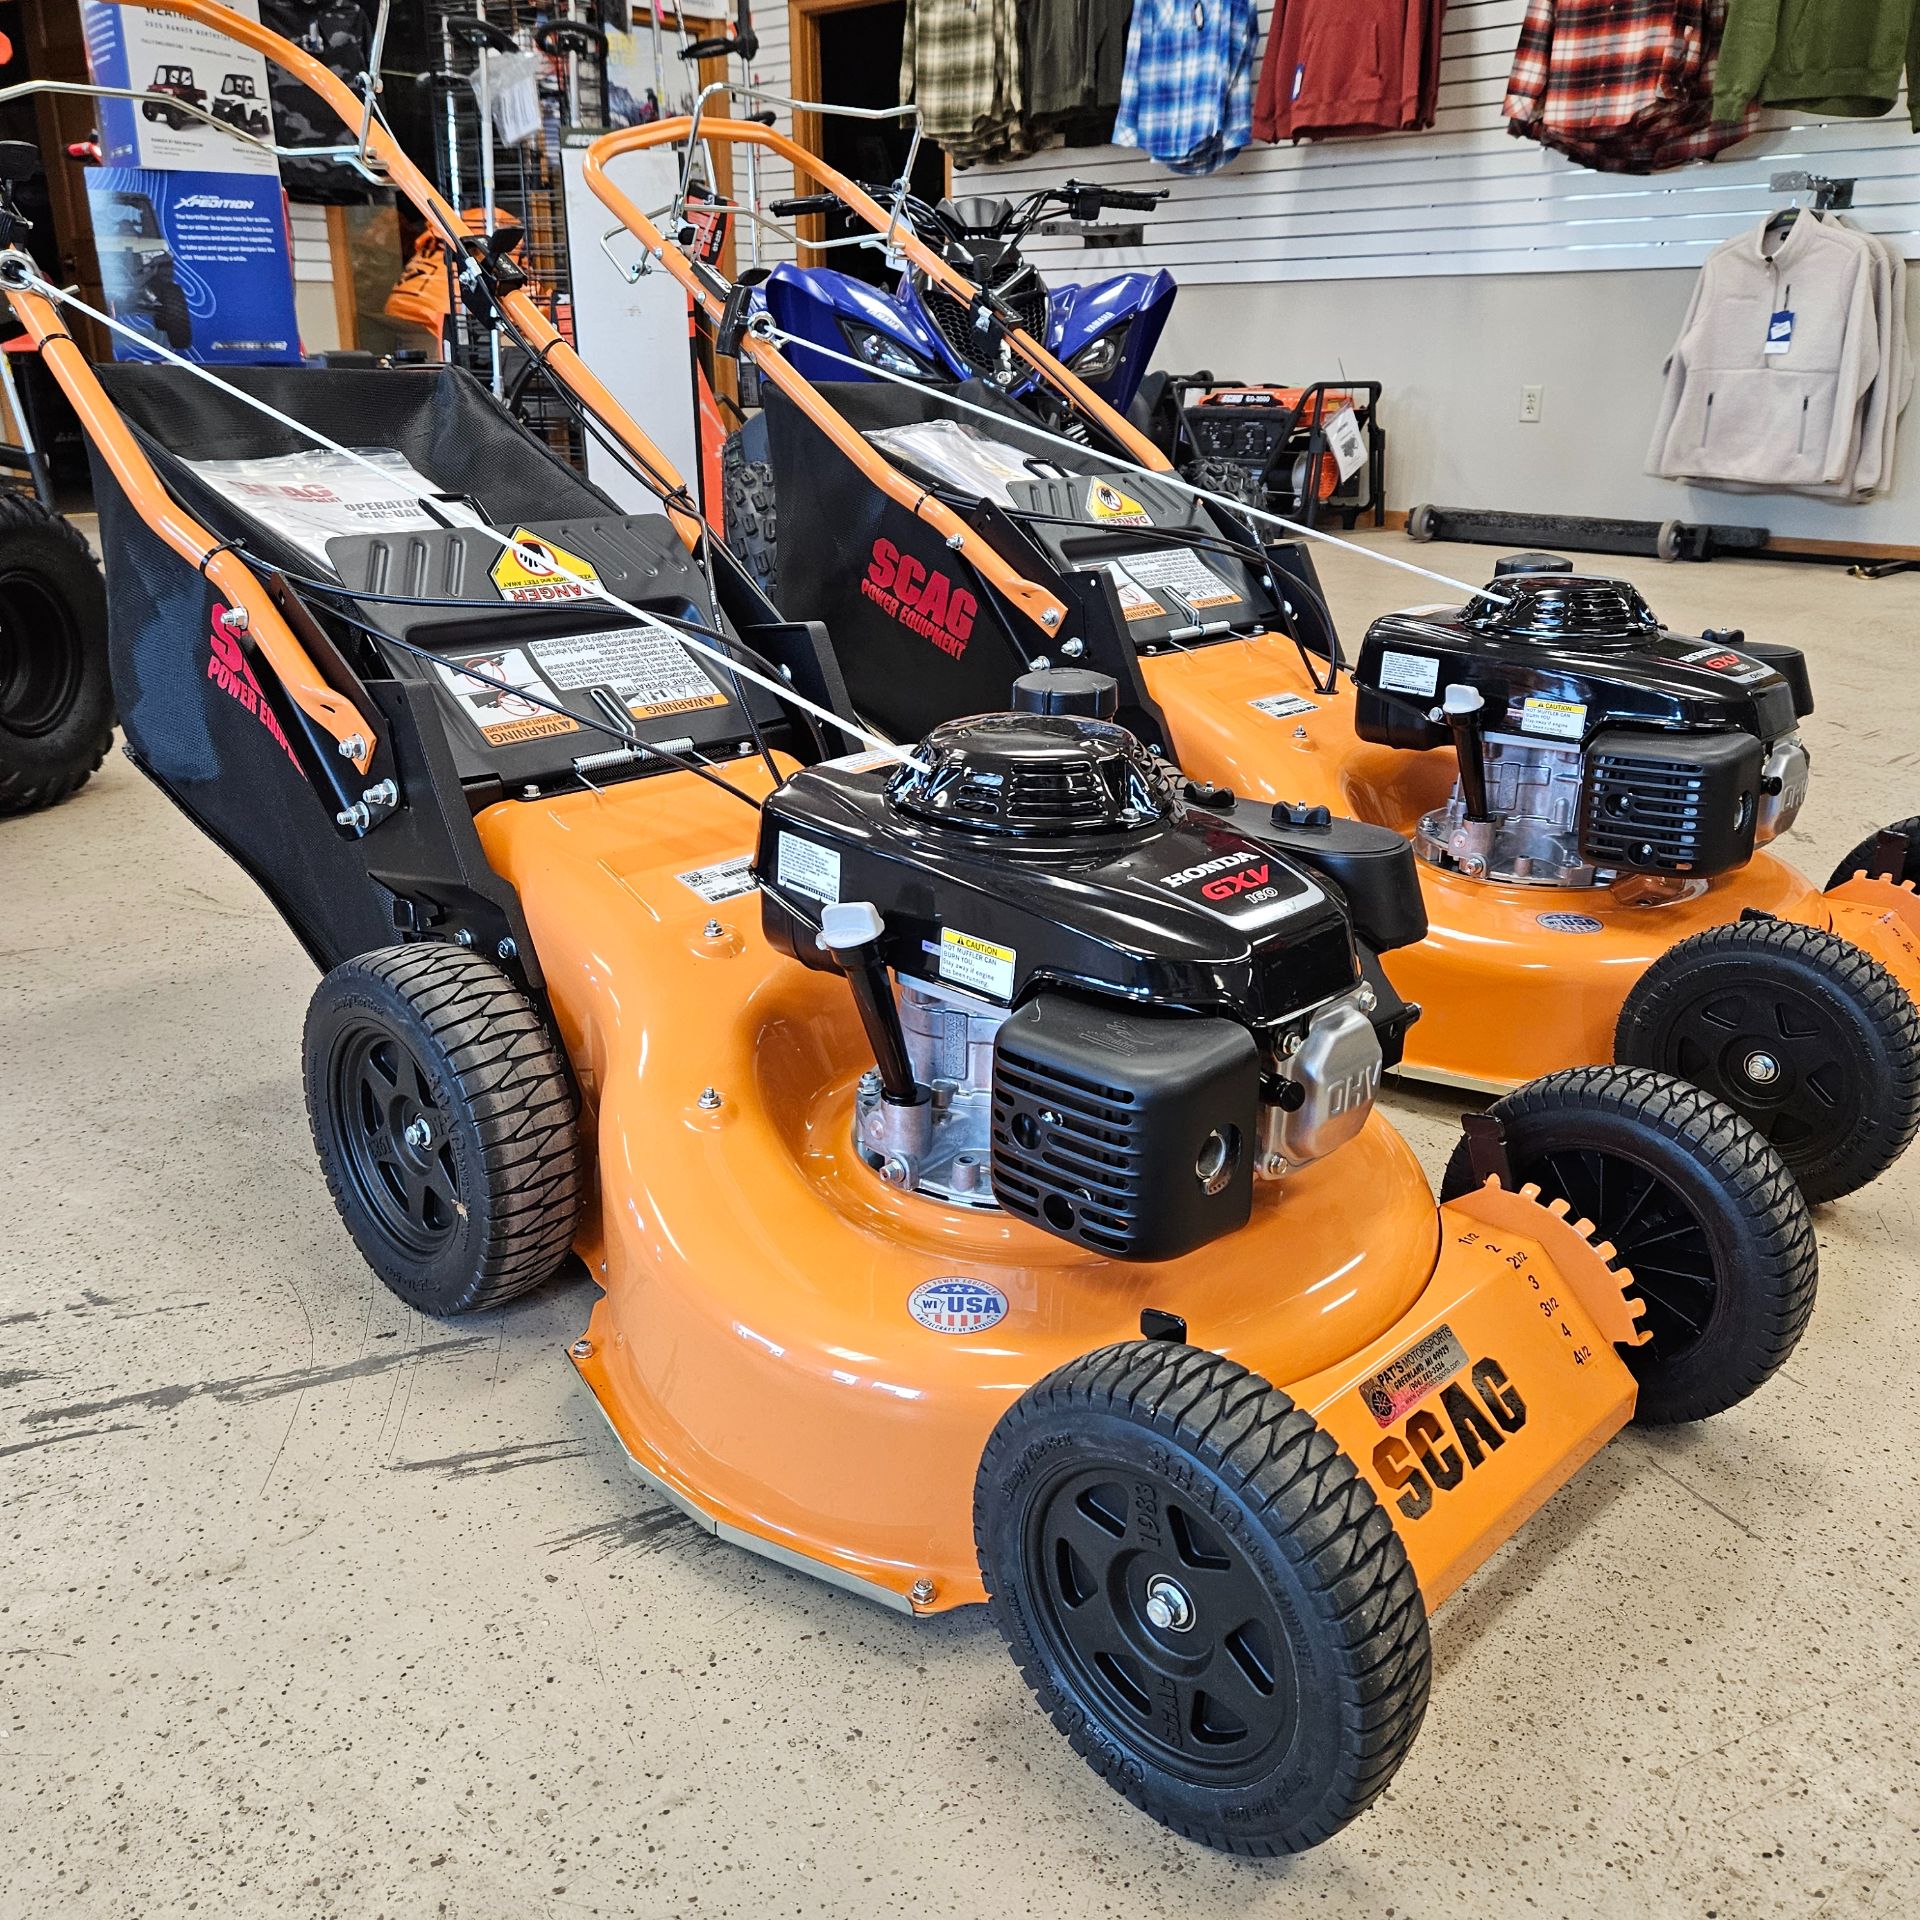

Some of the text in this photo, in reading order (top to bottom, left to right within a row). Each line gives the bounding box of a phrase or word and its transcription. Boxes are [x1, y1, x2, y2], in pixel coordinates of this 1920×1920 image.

[173, 195, 254, 209] XPEDITION
[1083, 311, 1116, 334] YAMAHA
[510, 583, 594, 601] ANGER
[868, 538, 978, 641] SCAG
[862, 578, 967, 661] POWER EQUIPMENT
[529, 642, 548, 651] Scag
[1706, 654, 1740, 669] GXV
[208, 655, 257, 715] POWER
[615, 673, 707, 694] BEFORE OPERATING
[646, 698, 705, 715] WARNING
[1546, 703, 1572, 712] CAUTION
[532, 716, 552, 725] OPERATE
[490, 724, 562, 743] WARNING
[1160, 852, 1260, 888] HONDA
[1202, 864, 1269, 900] GXV
[1244, 887, 1278, 904] 160
[944, 944, 955, 952] HOT
[956, 948, 982, 960] MUFFLER
[984, 956, 996, 966] CAN
[944, 951, 960, 960] BURN
[966, 940, 998, 956] CAUTION
[942, 966, 952, 974] has
[952, 970, 966, 978] been
[943, 958, 954, 968] Stay
[955, 962, 969, 973] away
[976, 970, 994, 980] engine
[1328, 1060, 1382, 1114] OHV
[1485, 1244, 1502, 1253] 2
[933, 1278, 960, 1286] POWER
[962, 1279, 1000, 1296] EQUIPMENT
[1528, 1274, 1540, 1290] 3
[922, 1296, 1001, 1314] WI USA
[919, 1316, 955, 1332] METALCRAFT
[970, 1316, 998, 1331] MAYVILLE
[1561, 1322, 1572, 1338] 4
[1376, 1326, 1452, 1388] PAT'S MOTORSPORTS
[1394, 1344, 1450, 1390] GREENLAND, MI 49929
[1372, 1356, 1528, 1520] SCAG
[1135, 1482, 1162, 1548] 1983
